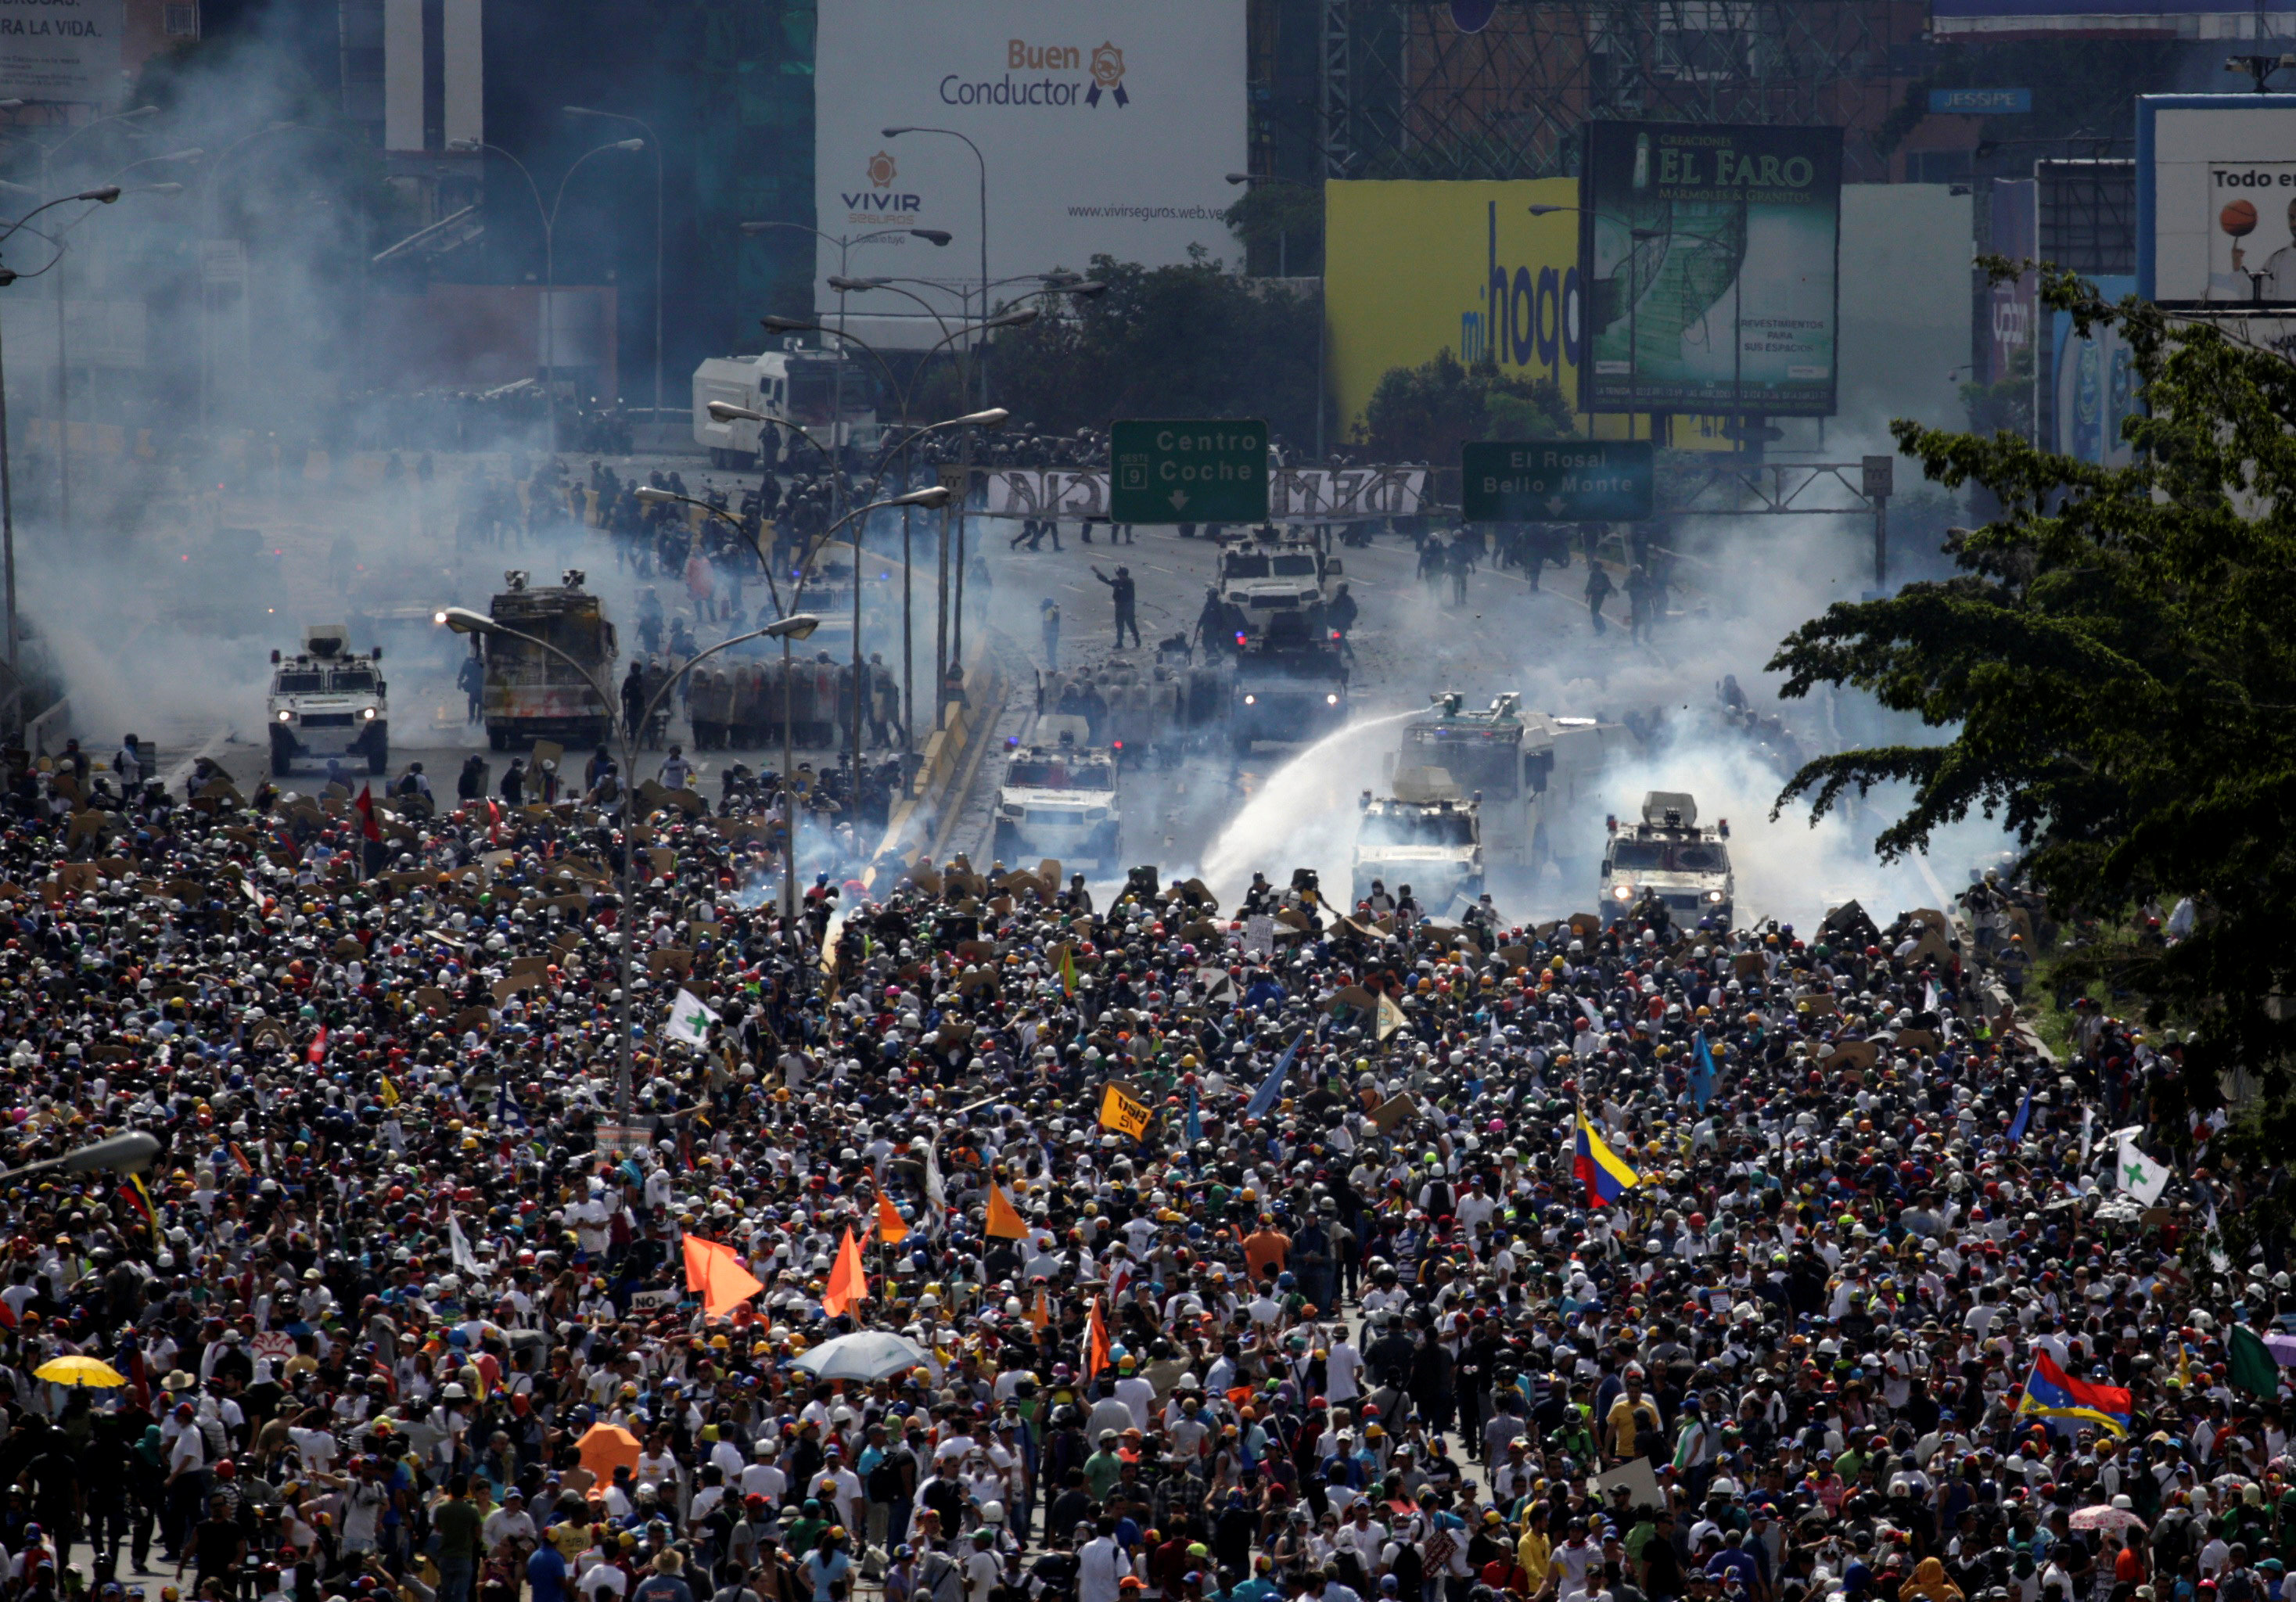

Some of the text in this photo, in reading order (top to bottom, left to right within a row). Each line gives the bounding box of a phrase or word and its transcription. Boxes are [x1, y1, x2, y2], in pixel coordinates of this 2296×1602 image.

[29, 20, 51, 35] LA
[55, 20, 102, 38] VIDA.
[1008, 39, 1080, 69] Buen
[940, 73, 1081, 106] Conductor
[1659, 134, 1732, 146] CREACIONES
[1658, 148, 1814, 188] EL FARO
[2212, 169, 2296, 188] Todo e
[841, 192, 921, 212] VIVIR
[1747, 190, 1811, 203] GRANITOS
[1068, 203, 1223, 222] www.vivirseguros.web.ve
[1744, 343, 1763, 351] SUS
[1156, 431, 1257, 451] Centro
[1119, 453, 1150, 463] OESTE
[1511, 447, 1606, 469] El Rosal
[1129, 469, 1141, 484] 9
[1159, 460, 1252, 482] Coche
[1483, 476, 1633, 494] Bello Monte
